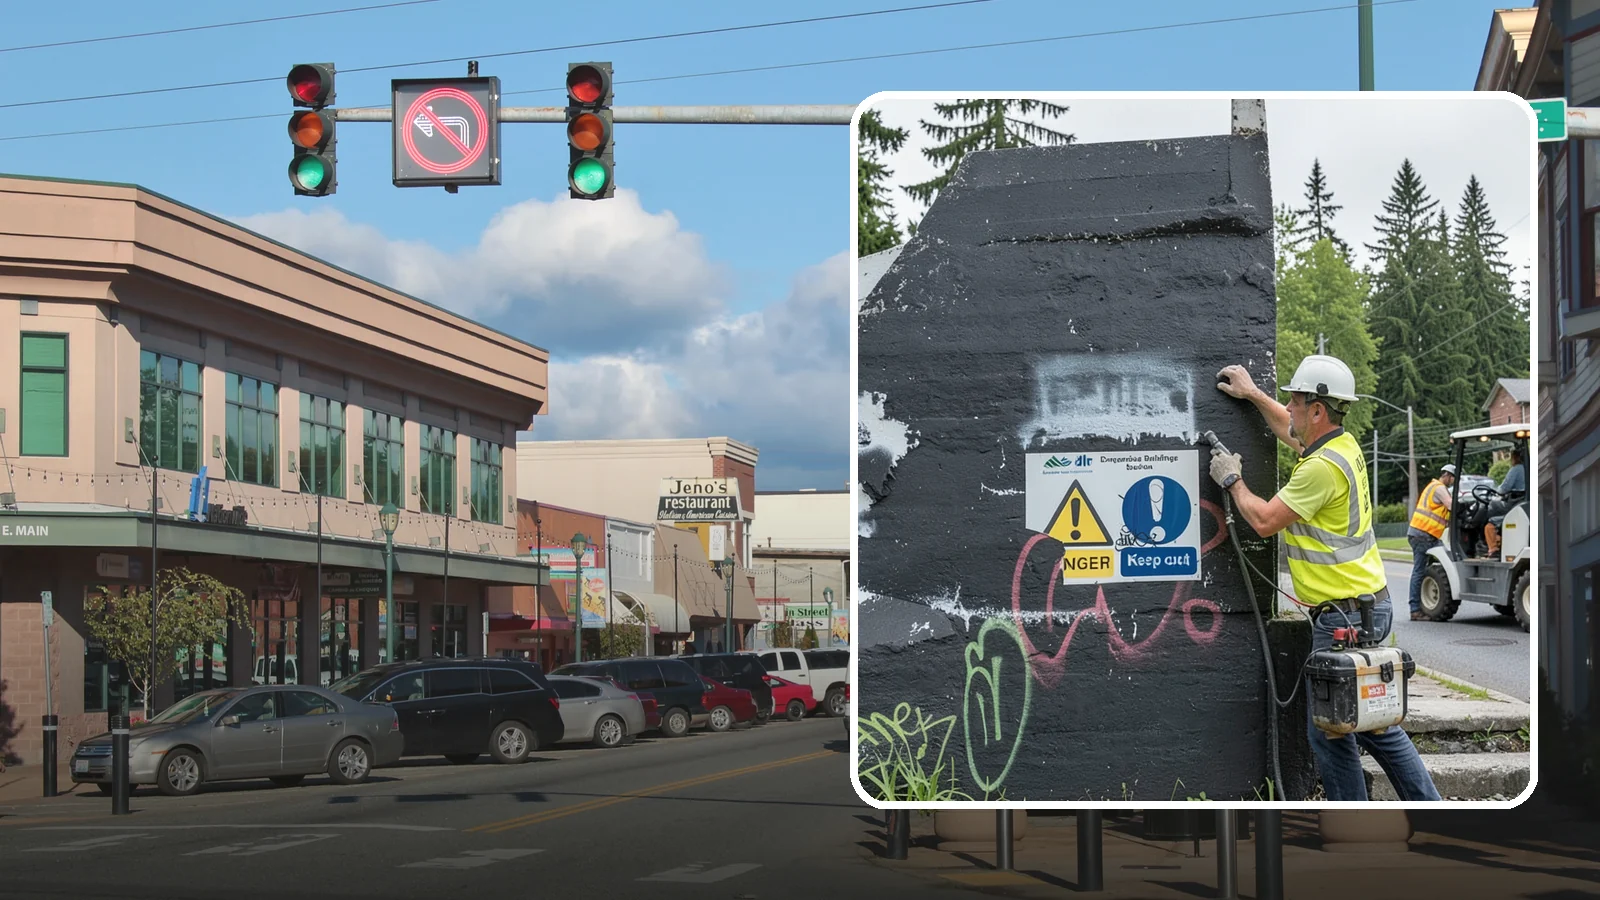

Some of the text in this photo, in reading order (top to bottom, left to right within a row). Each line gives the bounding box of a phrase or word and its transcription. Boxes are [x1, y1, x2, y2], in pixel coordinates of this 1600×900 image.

[669, 480, 727, 495] Jeno's
[665, 496, 731, 509] restaurant
[658, 510, 682, 519] Italian
[686, 509, 715, 519] American
[715, 509, 738, 519] Cuisine
[2, 525, 49, 536] E. MAIN
[1063, 556, 1111, 571] NGER
[1127, 553, 1161, 569] Keep
[797, 607, 828, 617] Street
